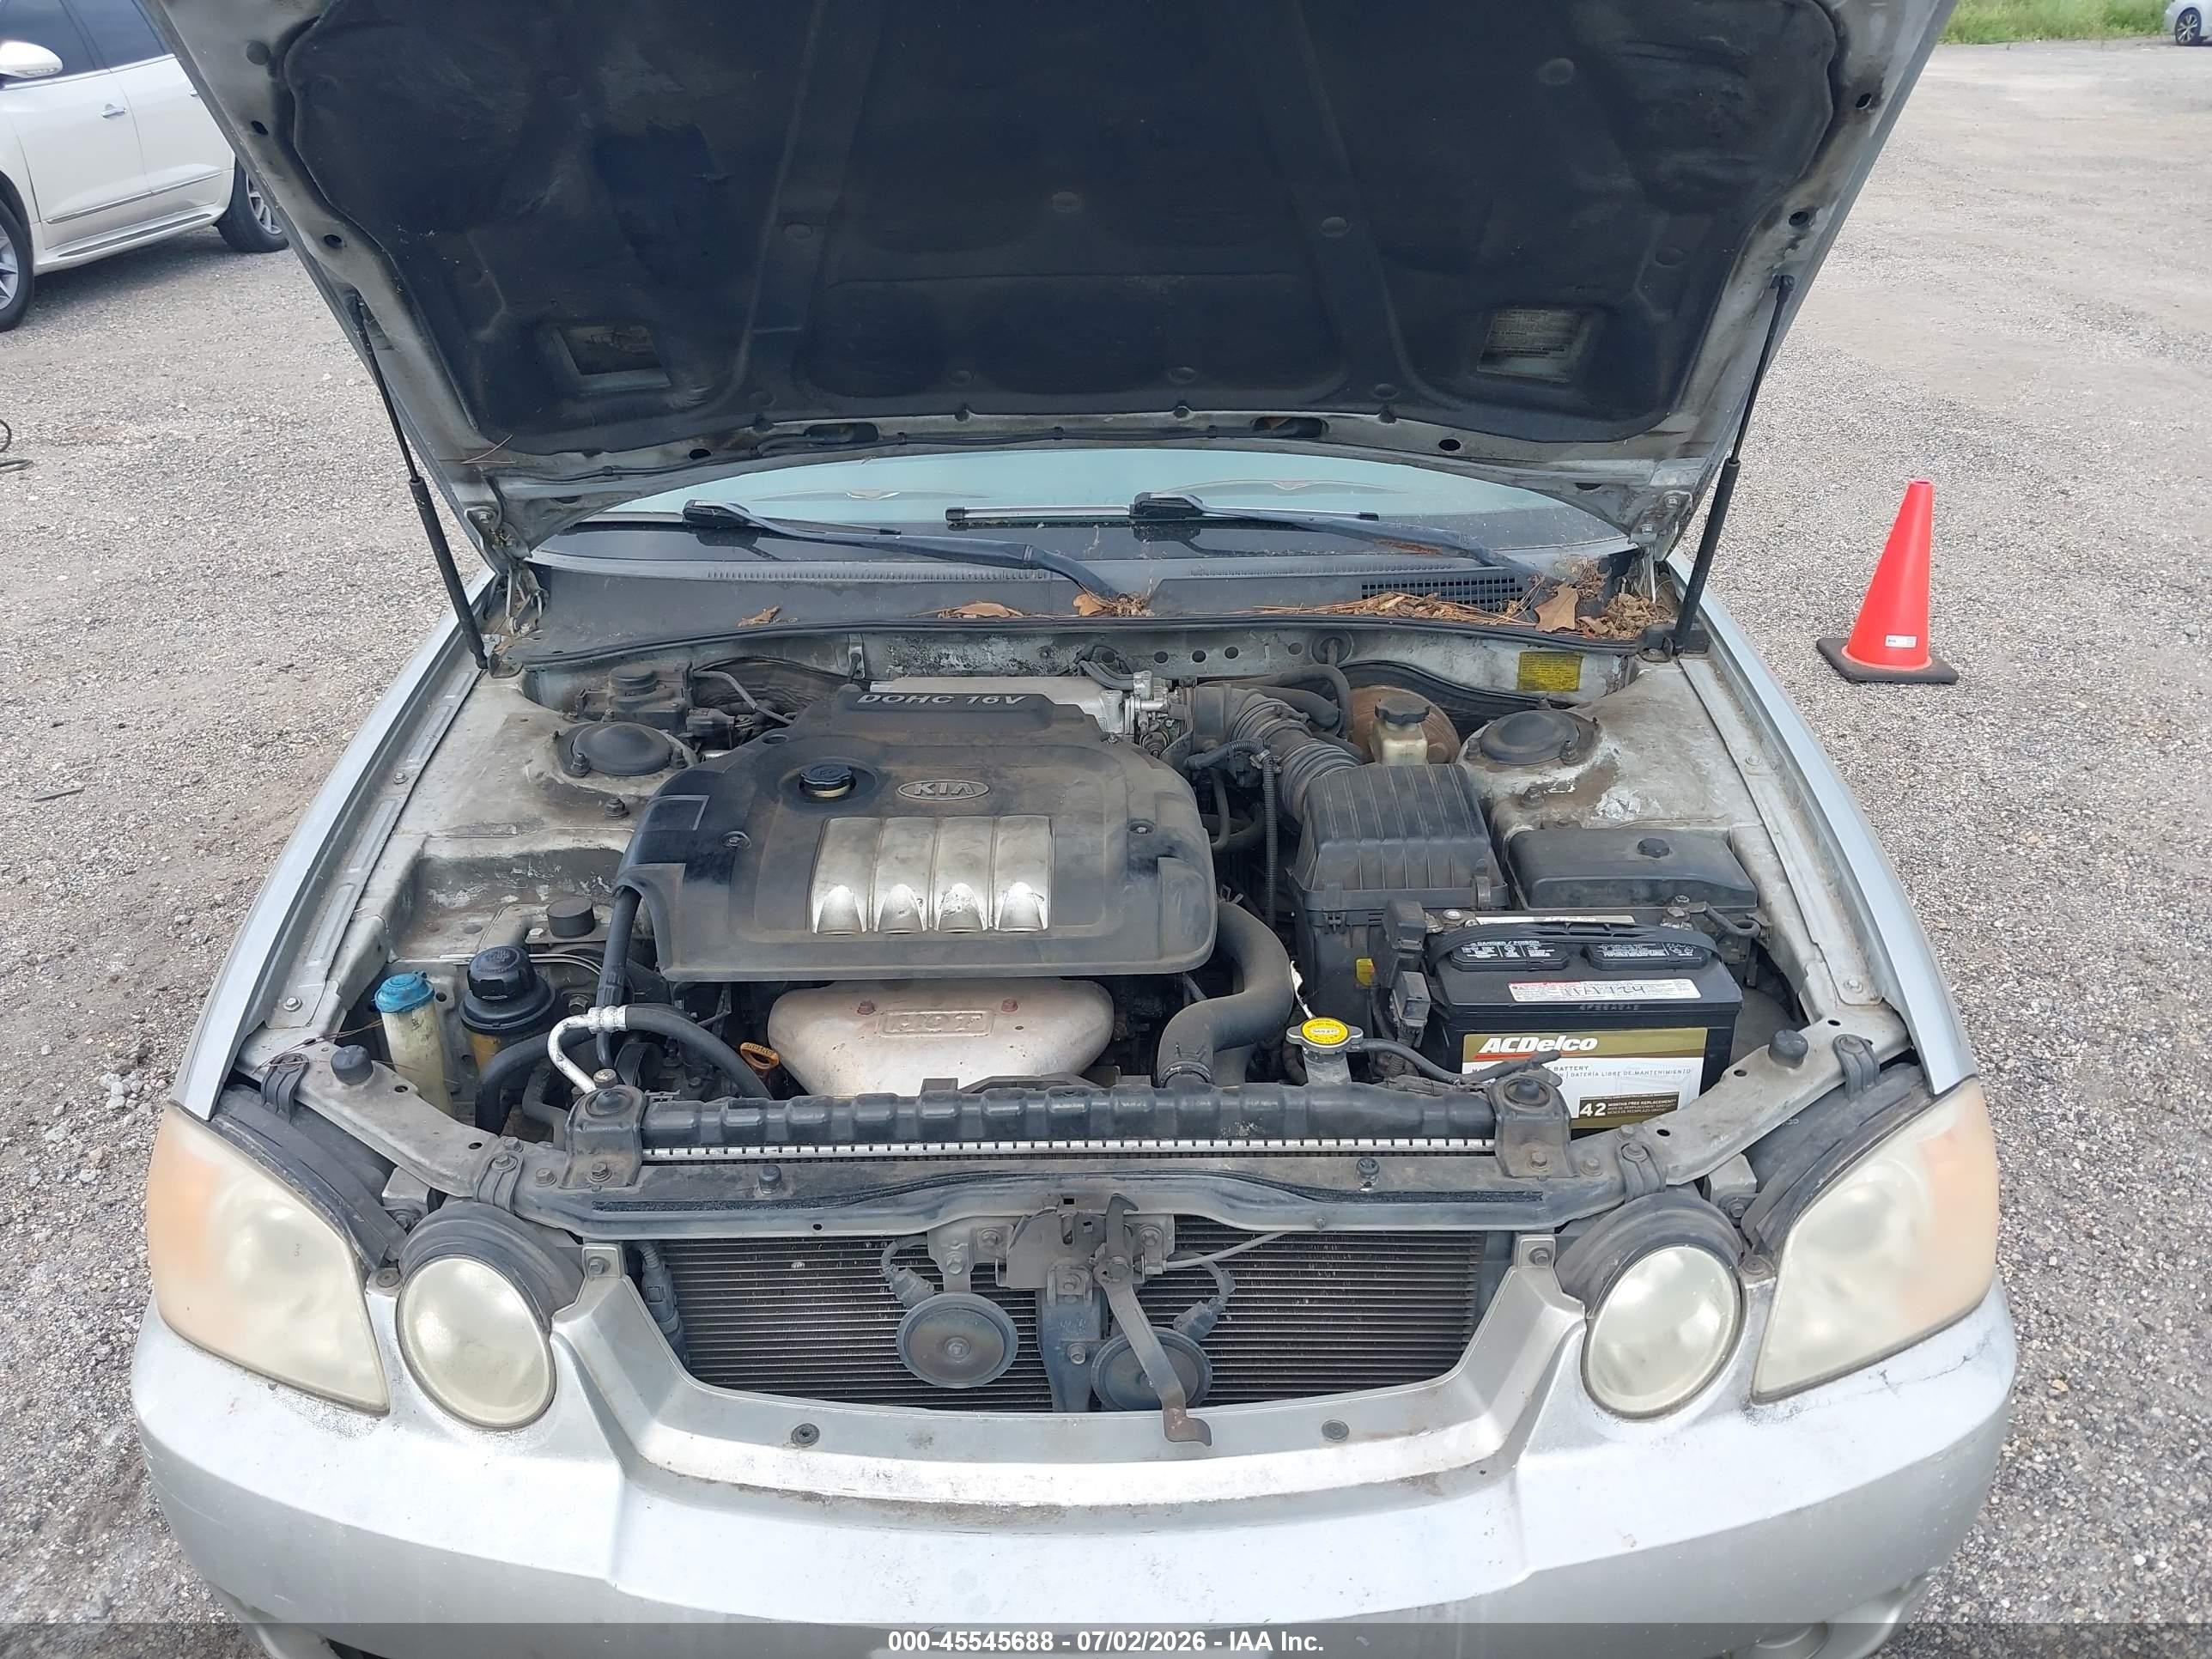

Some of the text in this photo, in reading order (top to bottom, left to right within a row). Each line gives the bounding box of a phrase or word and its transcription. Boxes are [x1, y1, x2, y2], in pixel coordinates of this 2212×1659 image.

[857, 695, 1027, 705] DOHC 16V
[913, 782, 975, 796] KIA
[889, 1012, 983, 1032] HOT
[1478, 1035, 1598, 1054] ACDelco
[1579, 1103, 1607, 1117] 42
